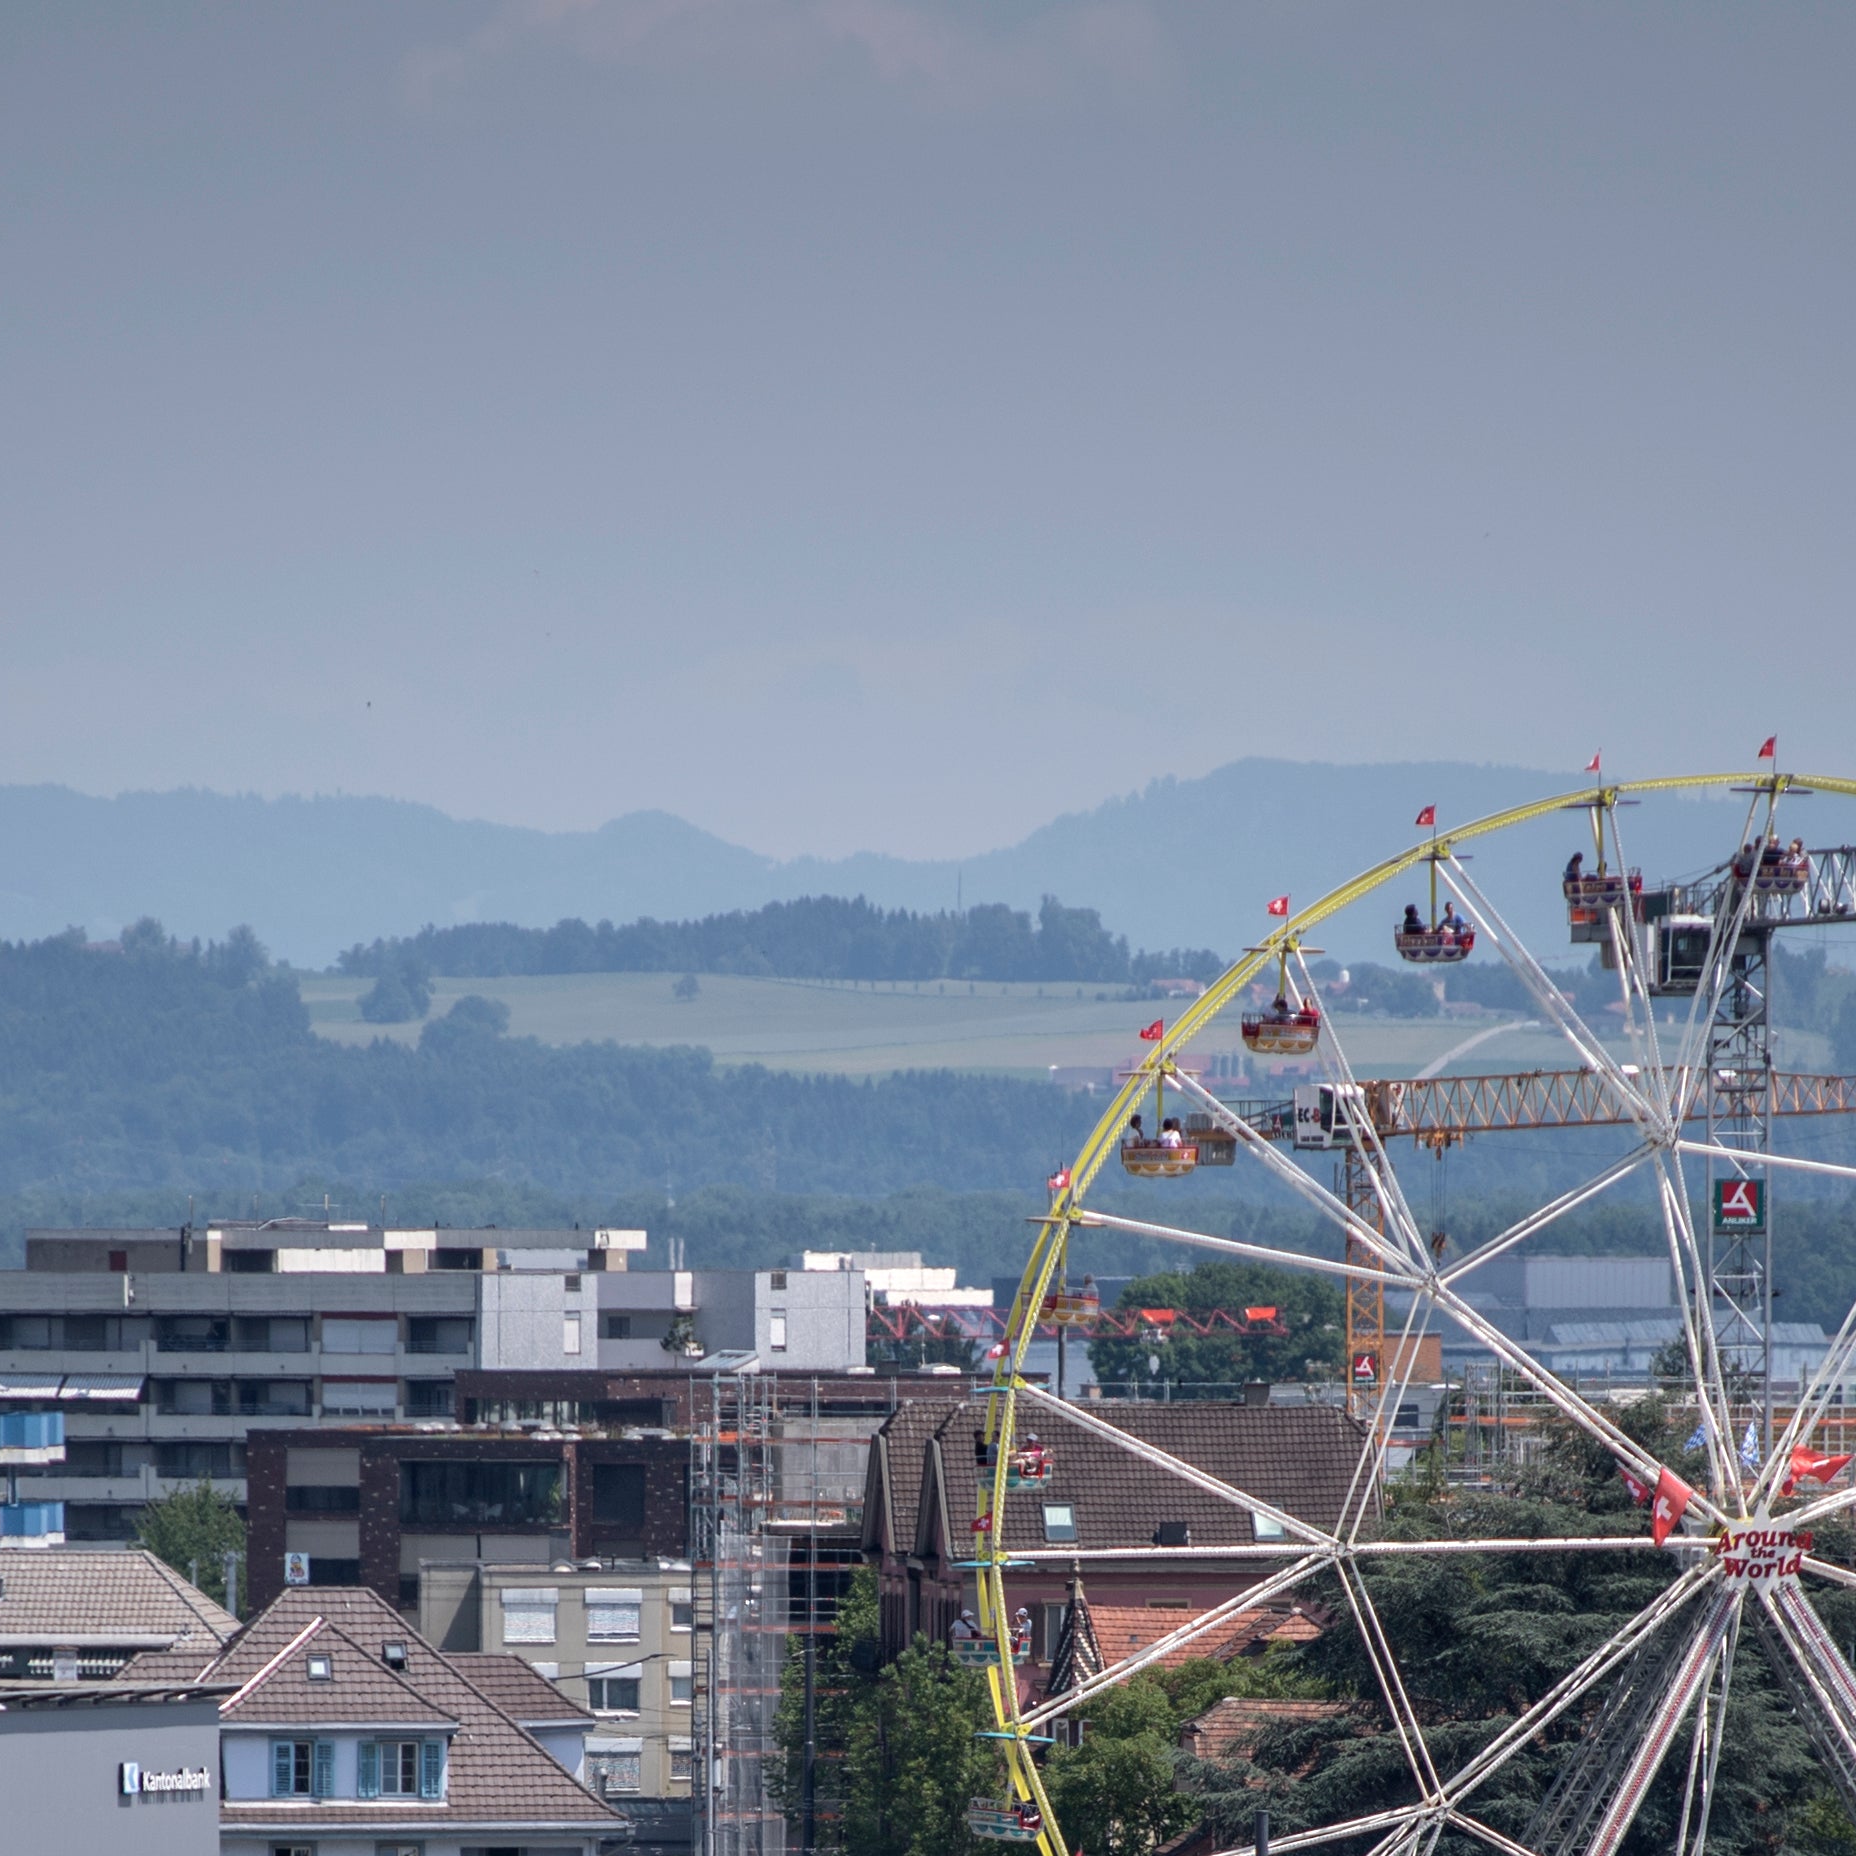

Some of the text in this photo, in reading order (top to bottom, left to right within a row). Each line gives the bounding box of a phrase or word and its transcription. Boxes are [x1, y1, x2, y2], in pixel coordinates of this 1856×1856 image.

[1714, 1530, 1814, 1556] Around
[1750, 1547, 1776, 1559] the
[1724, 1551, 1803, 1579] World
[143, 1767, 211, 1792] Kantonalbank
